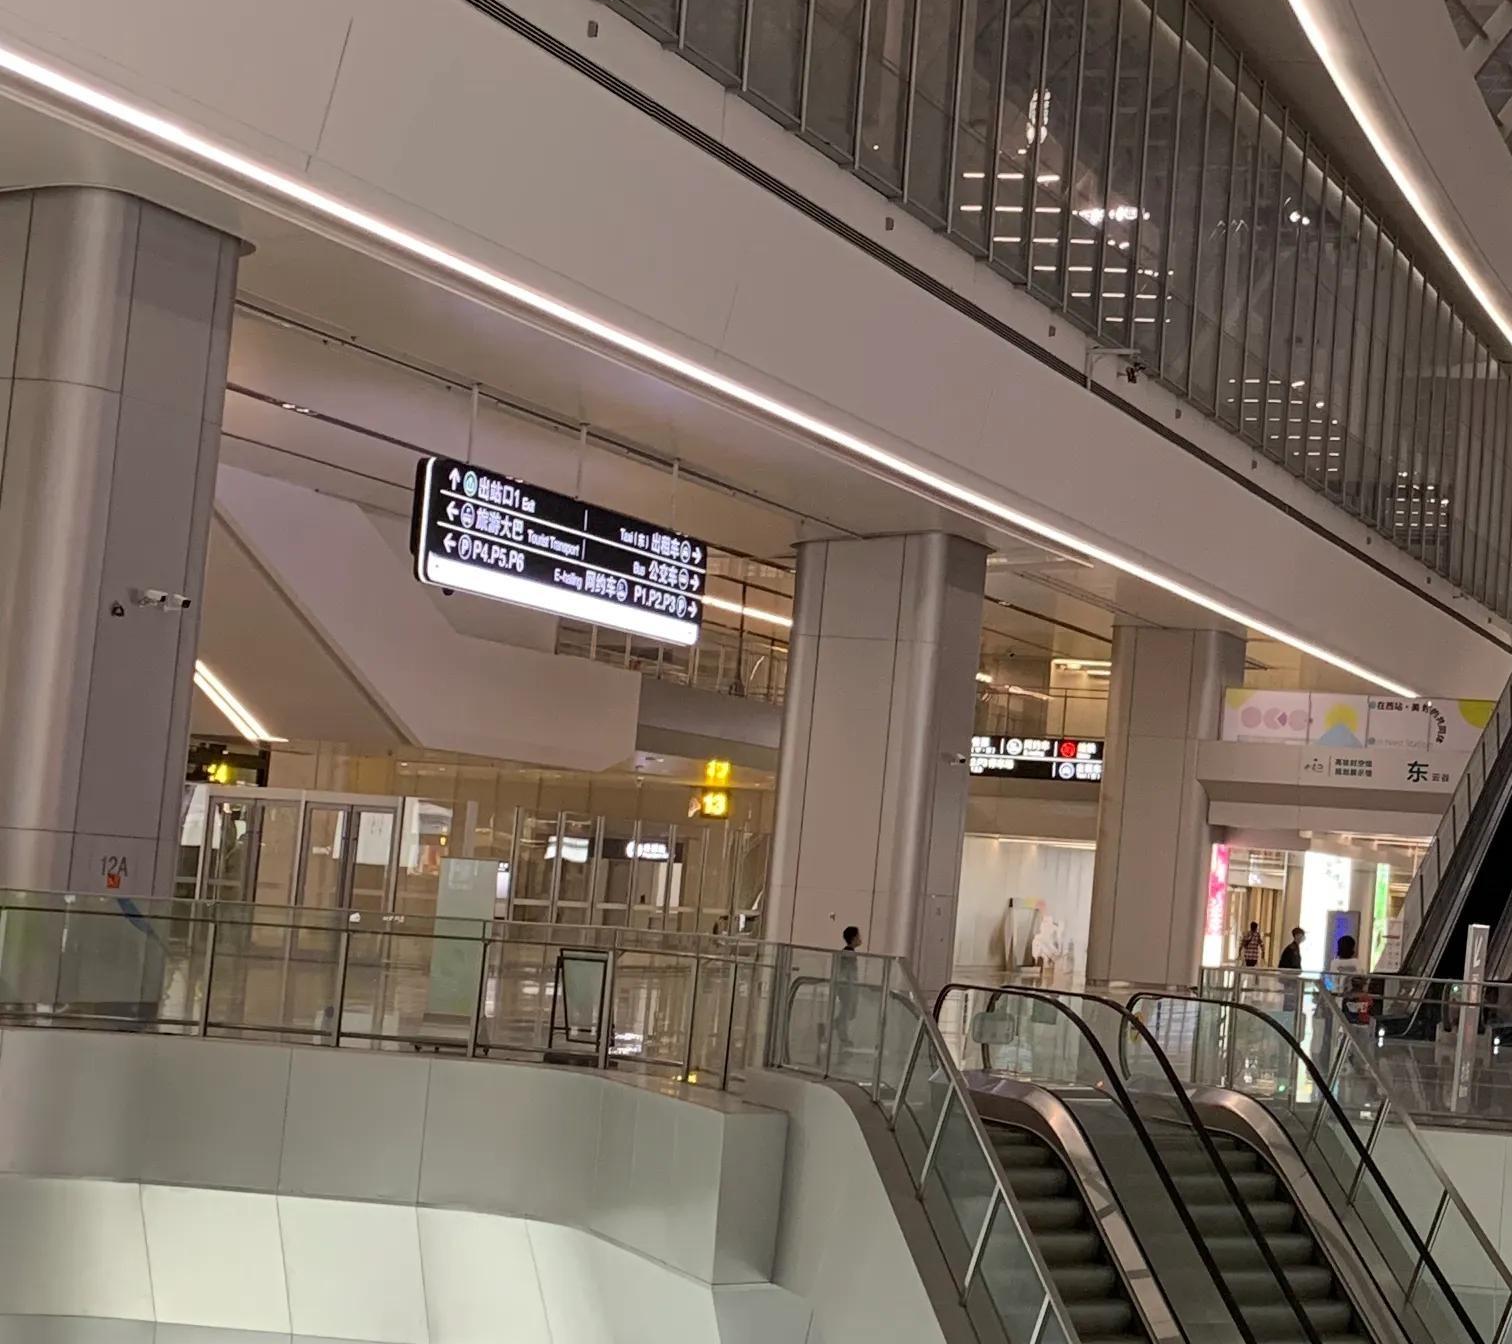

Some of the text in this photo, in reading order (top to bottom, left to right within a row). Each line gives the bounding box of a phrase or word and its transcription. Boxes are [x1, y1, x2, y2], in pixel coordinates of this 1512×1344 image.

[478, 476, 521, 508] 出站口1
[475, 506, 524, 541] 旅游大巴
[651, 532, 680, 560] 出租车
[584, 569, 617, 598] 网约车
[648, 559, 678, 588] 公交车
[1406, 760, 1429, 782] 东
[100, 856, 128, 877] 12A
